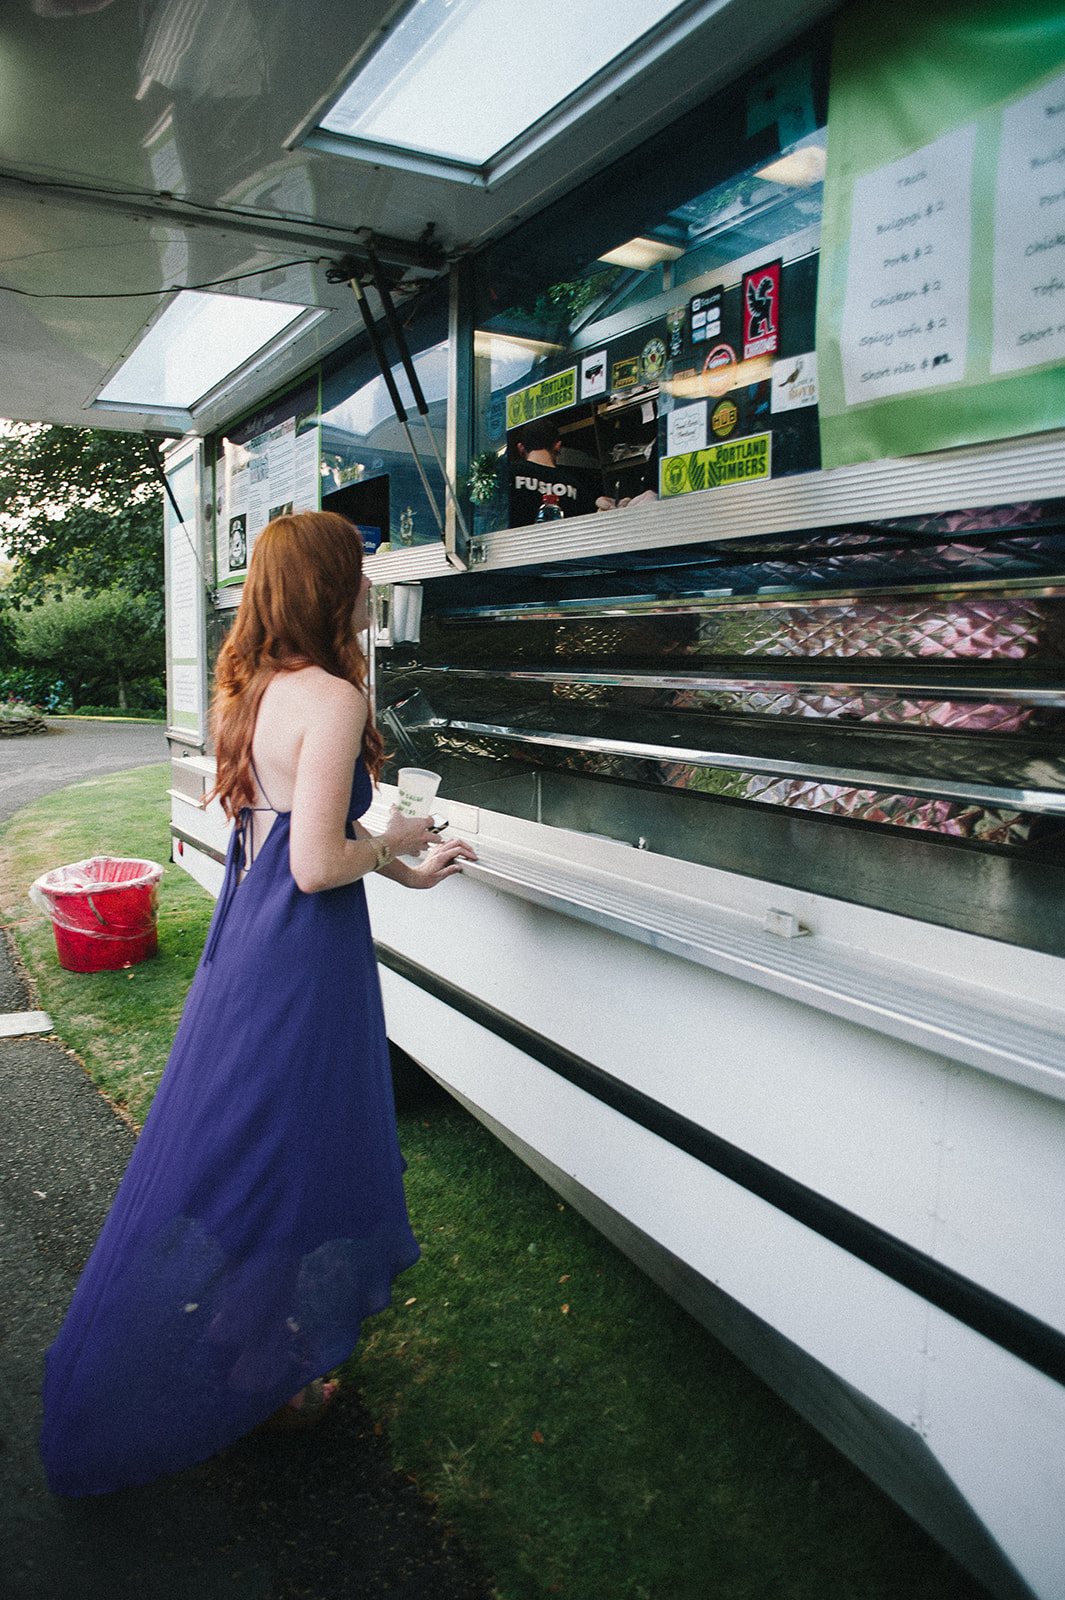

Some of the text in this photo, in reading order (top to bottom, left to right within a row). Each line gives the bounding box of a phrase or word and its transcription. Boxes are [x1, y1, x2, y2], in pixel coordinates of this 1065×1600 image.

[717, 439, 767, 463] PORTLAND
[717, 456, 766, 480] TIMBERS
[515, 476, 577, 500] FUSION
